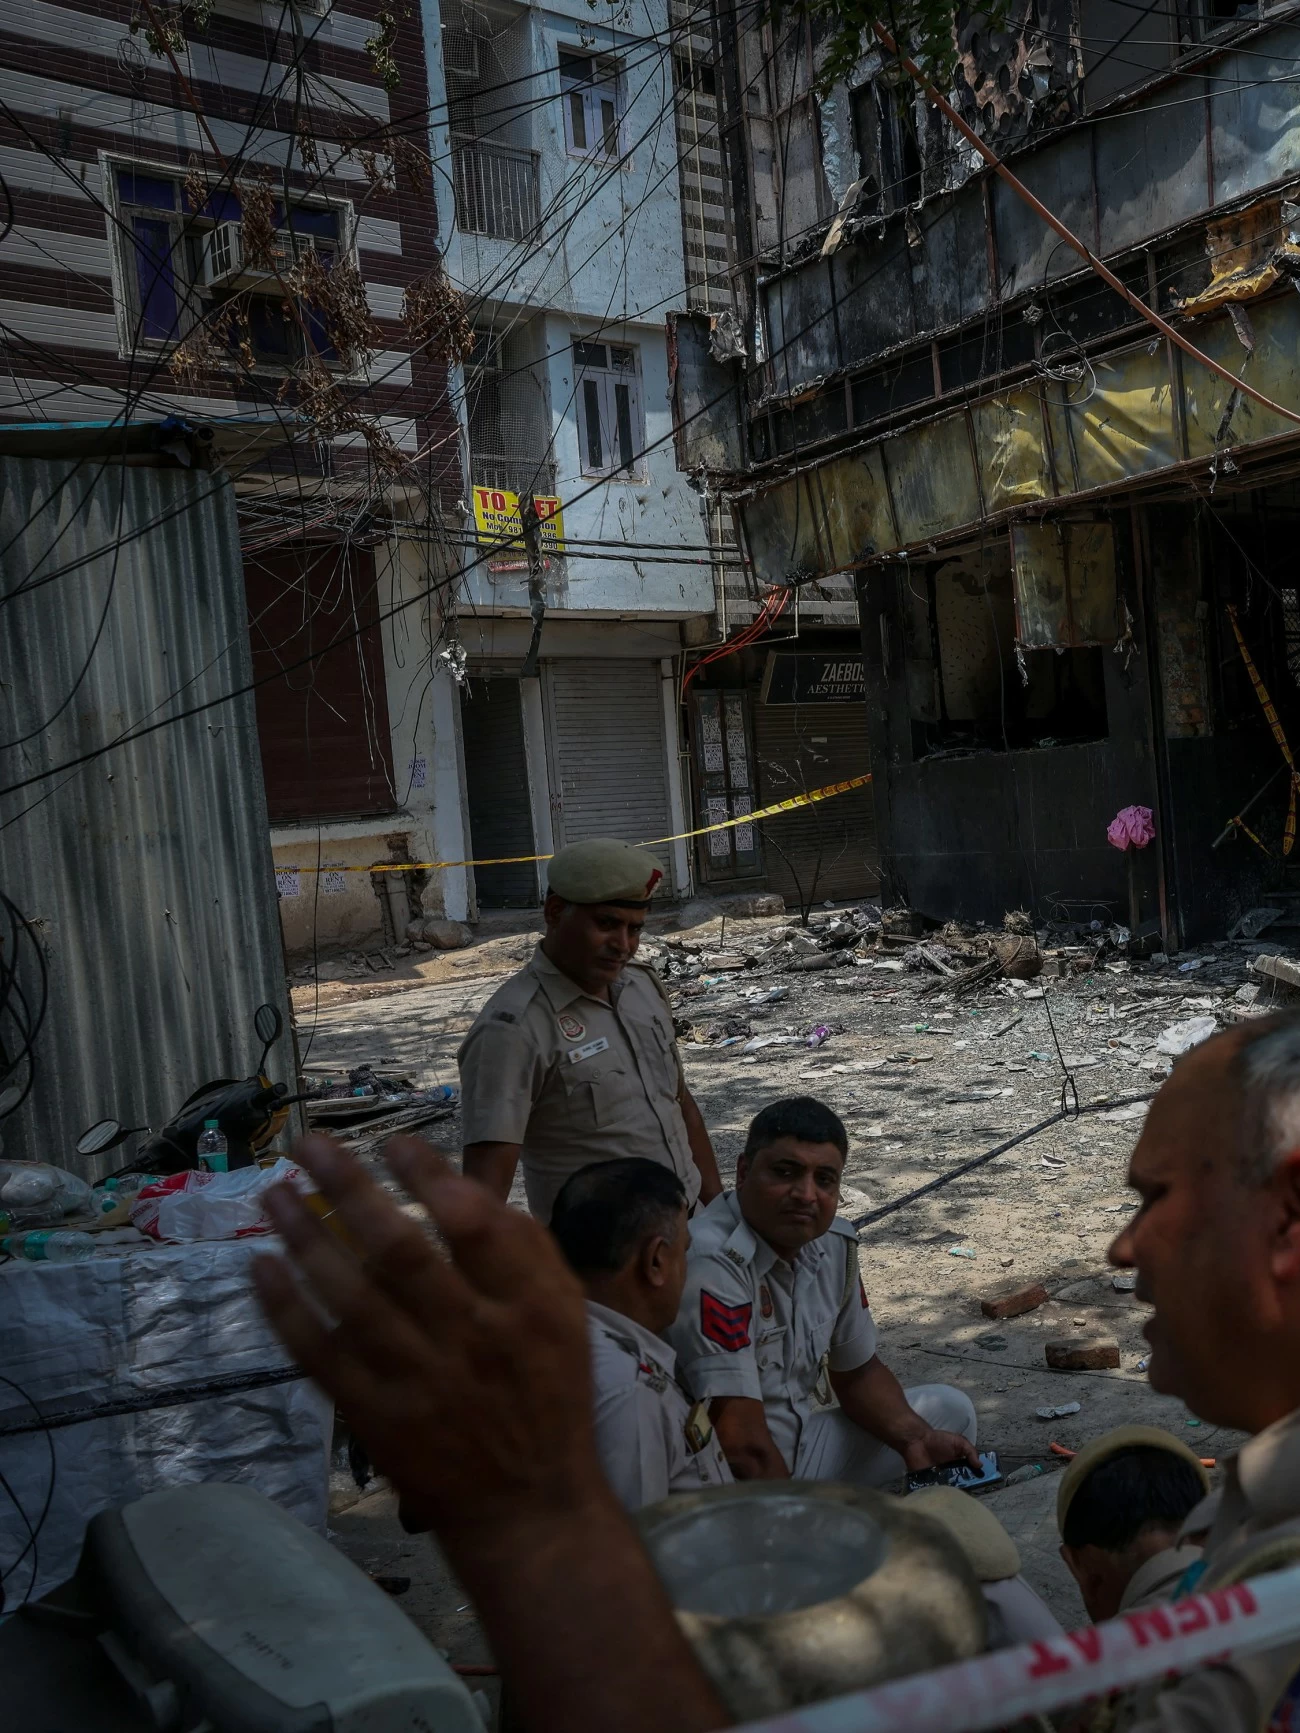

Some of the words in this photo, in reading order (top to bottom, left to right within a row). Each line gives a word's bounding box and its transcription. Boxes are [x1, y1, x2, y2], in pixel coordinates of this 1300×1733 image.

[476, 489, 507, 512] TO
[482, 511, 495, 520] No
[807, 683, 867, 694] AESTHETI
[1125, 1580, 1259, 1647] MEN
[1027, 1623, 1104, 1681] AT
